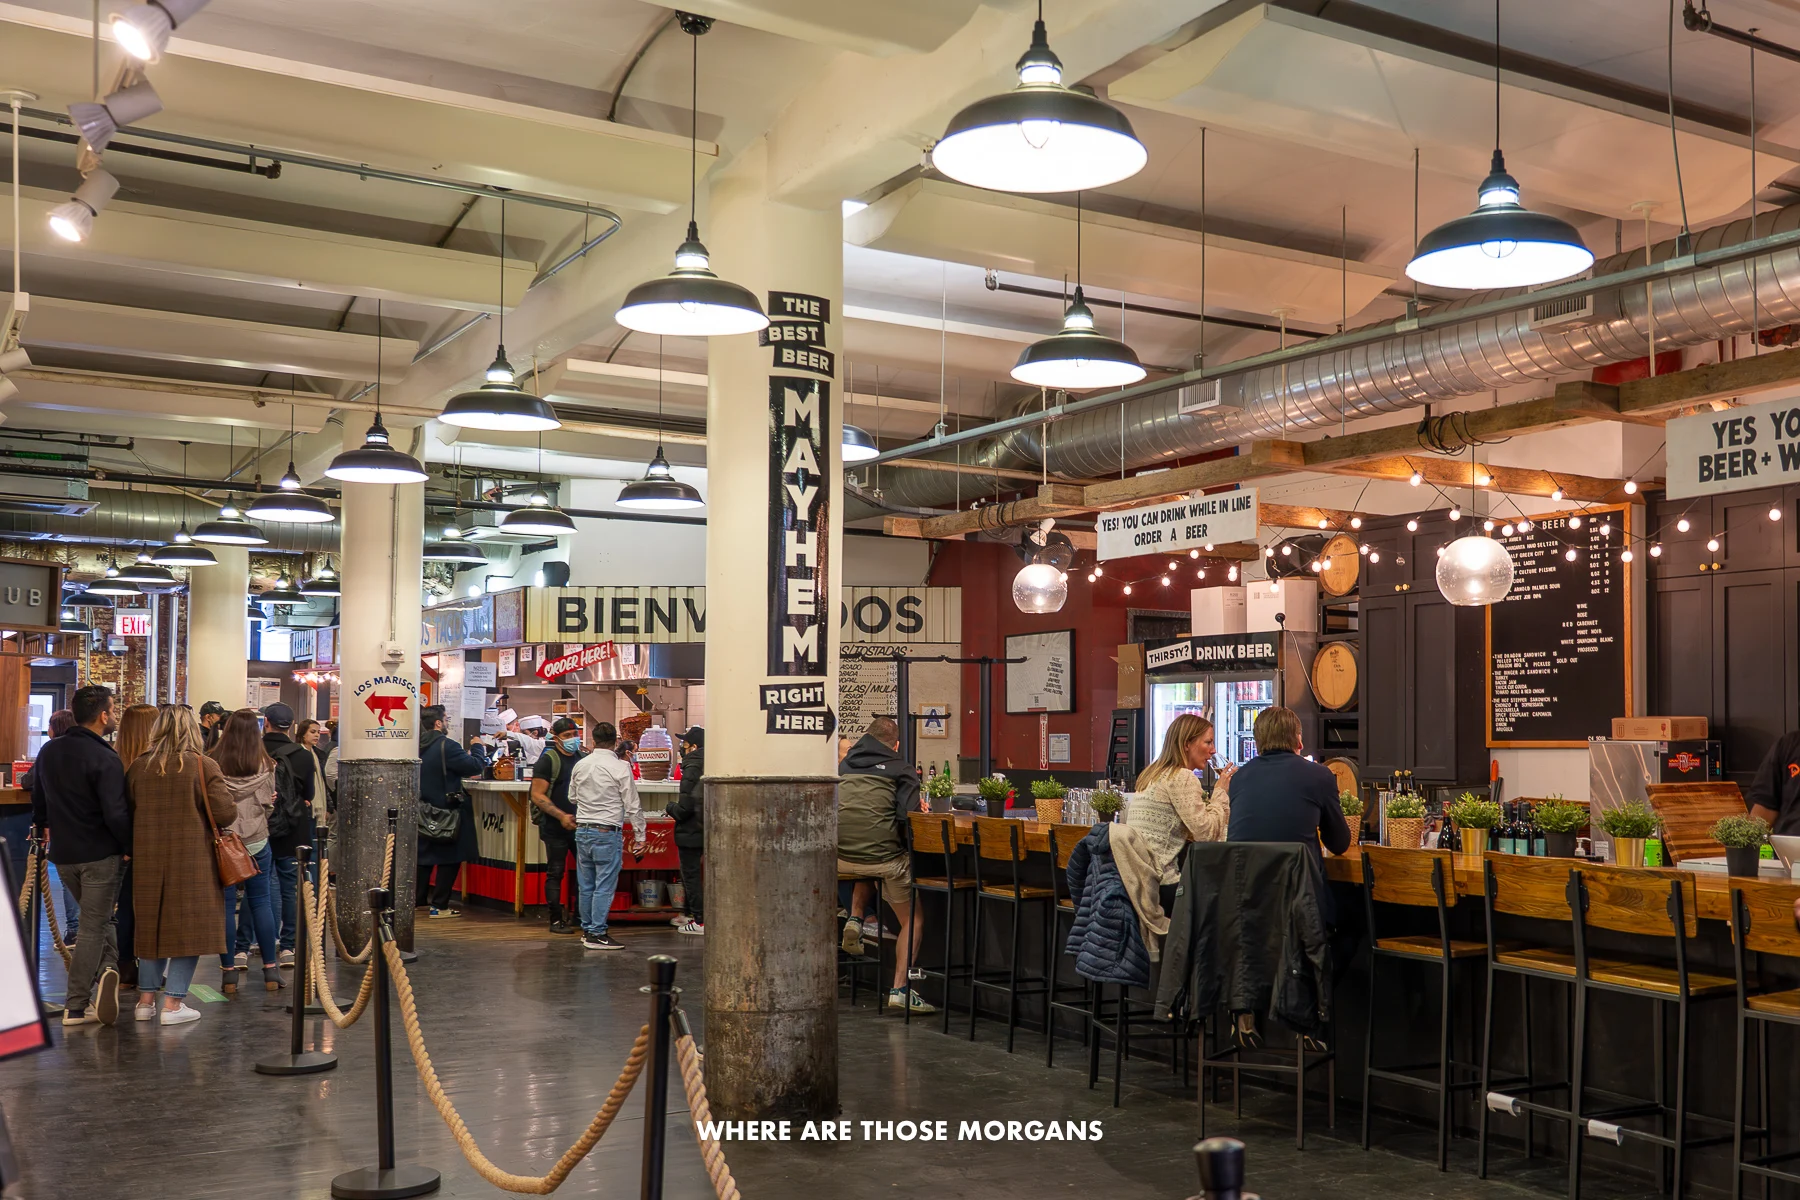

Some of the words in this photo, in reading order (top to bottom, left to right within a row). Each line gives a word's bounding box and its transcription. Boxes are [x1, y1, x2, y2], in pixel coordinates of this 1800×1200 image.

[782, 296, 821, 317] THE
[768, 326, 819, 342] BEST
[782, 348, 830, 372] BEER
[1712, 415, 1757, 450] YES
[1698, 448, 1758, 483] BEER
[1102, 517, 1119, 532] YES!
[1121, 515, 1139, 530] YOU
[1141, 511, 1159, 527] CAN
[1160, 505, 1186, 524] DRINK
[1189, 500, 1217, 518] WHILE
[1219, 499, 1229, 513] IN
[1231, 495, 1252, 512] LINE
[782, 386, 822, 663] MAYHEM
[1543, 520, 1564, 529] BEER
[1134, 529, 1162, 547] ORDER
[1170, 528, 1177, 542] A
[1185, 523, 1208, 540] BEER
[121, 616, 146, 635] EXIT
[433, 609, 469, 644] TACOS
[543, 655, 579, 678] ORDER
[580, 641, 611, 666] HERE!
[1148, 644, 1190, 664] THIRSTY?
[1195, 644, 1235, 661] DRINK
[1237, 643, 1276, 659] BEER.
[353, 680, 372, 697] LOS
[765, 687, 823, 705] RIGHT
[775, 714, 824, 731] HERE
[925, 708, 942, 728] A
[365, 730, 387, 738] THAT
[390, 730, 409, 738] WAY
[848, 725, 854, 733] A
[637, 752, 668, 760] TAMARINDO
